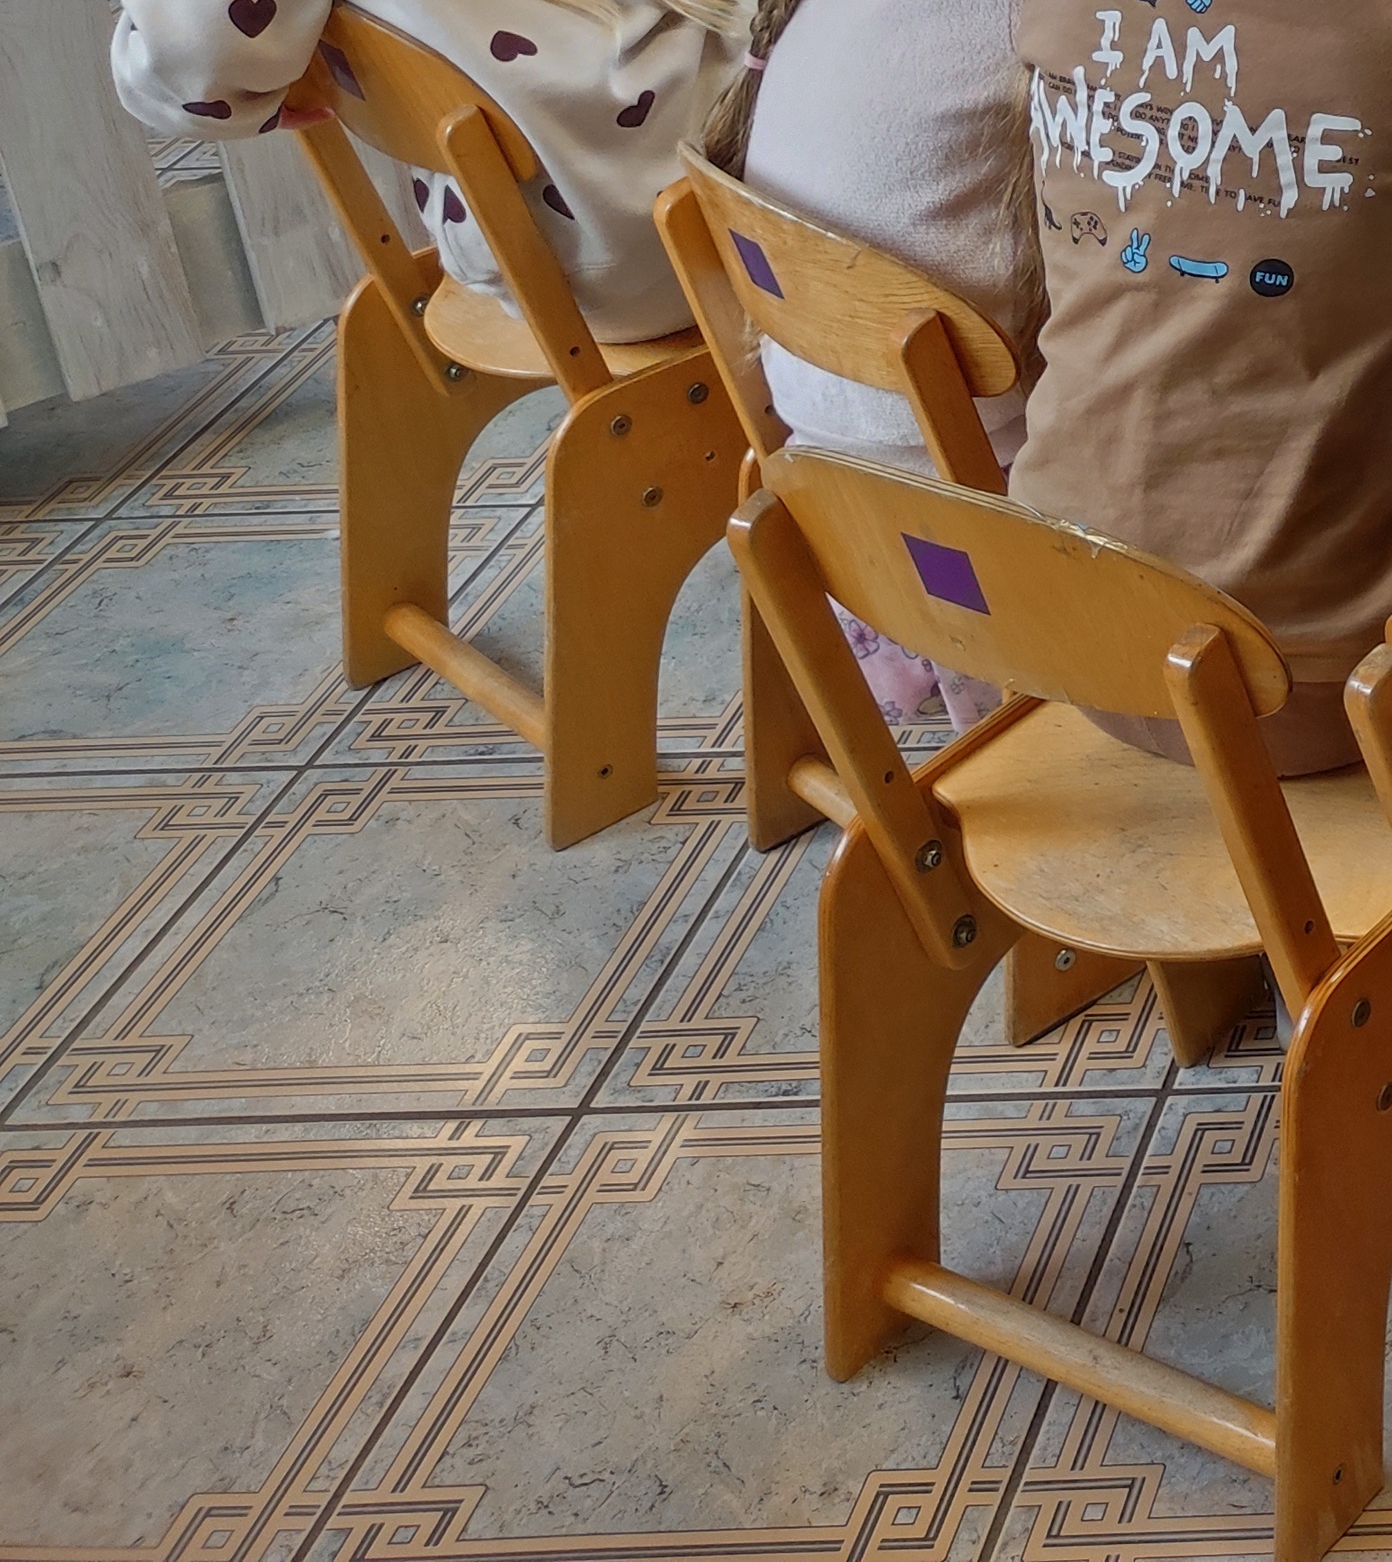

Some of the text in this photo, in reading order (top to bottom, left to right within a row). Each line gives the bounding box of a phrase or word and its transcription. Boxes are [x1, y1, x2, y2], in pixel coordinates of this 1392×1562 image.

[1091, 10, 1238, 97] I AM
[1030, 65, 1362, 218] AWESOME
[1255, 271, 1289, 286] FUN
